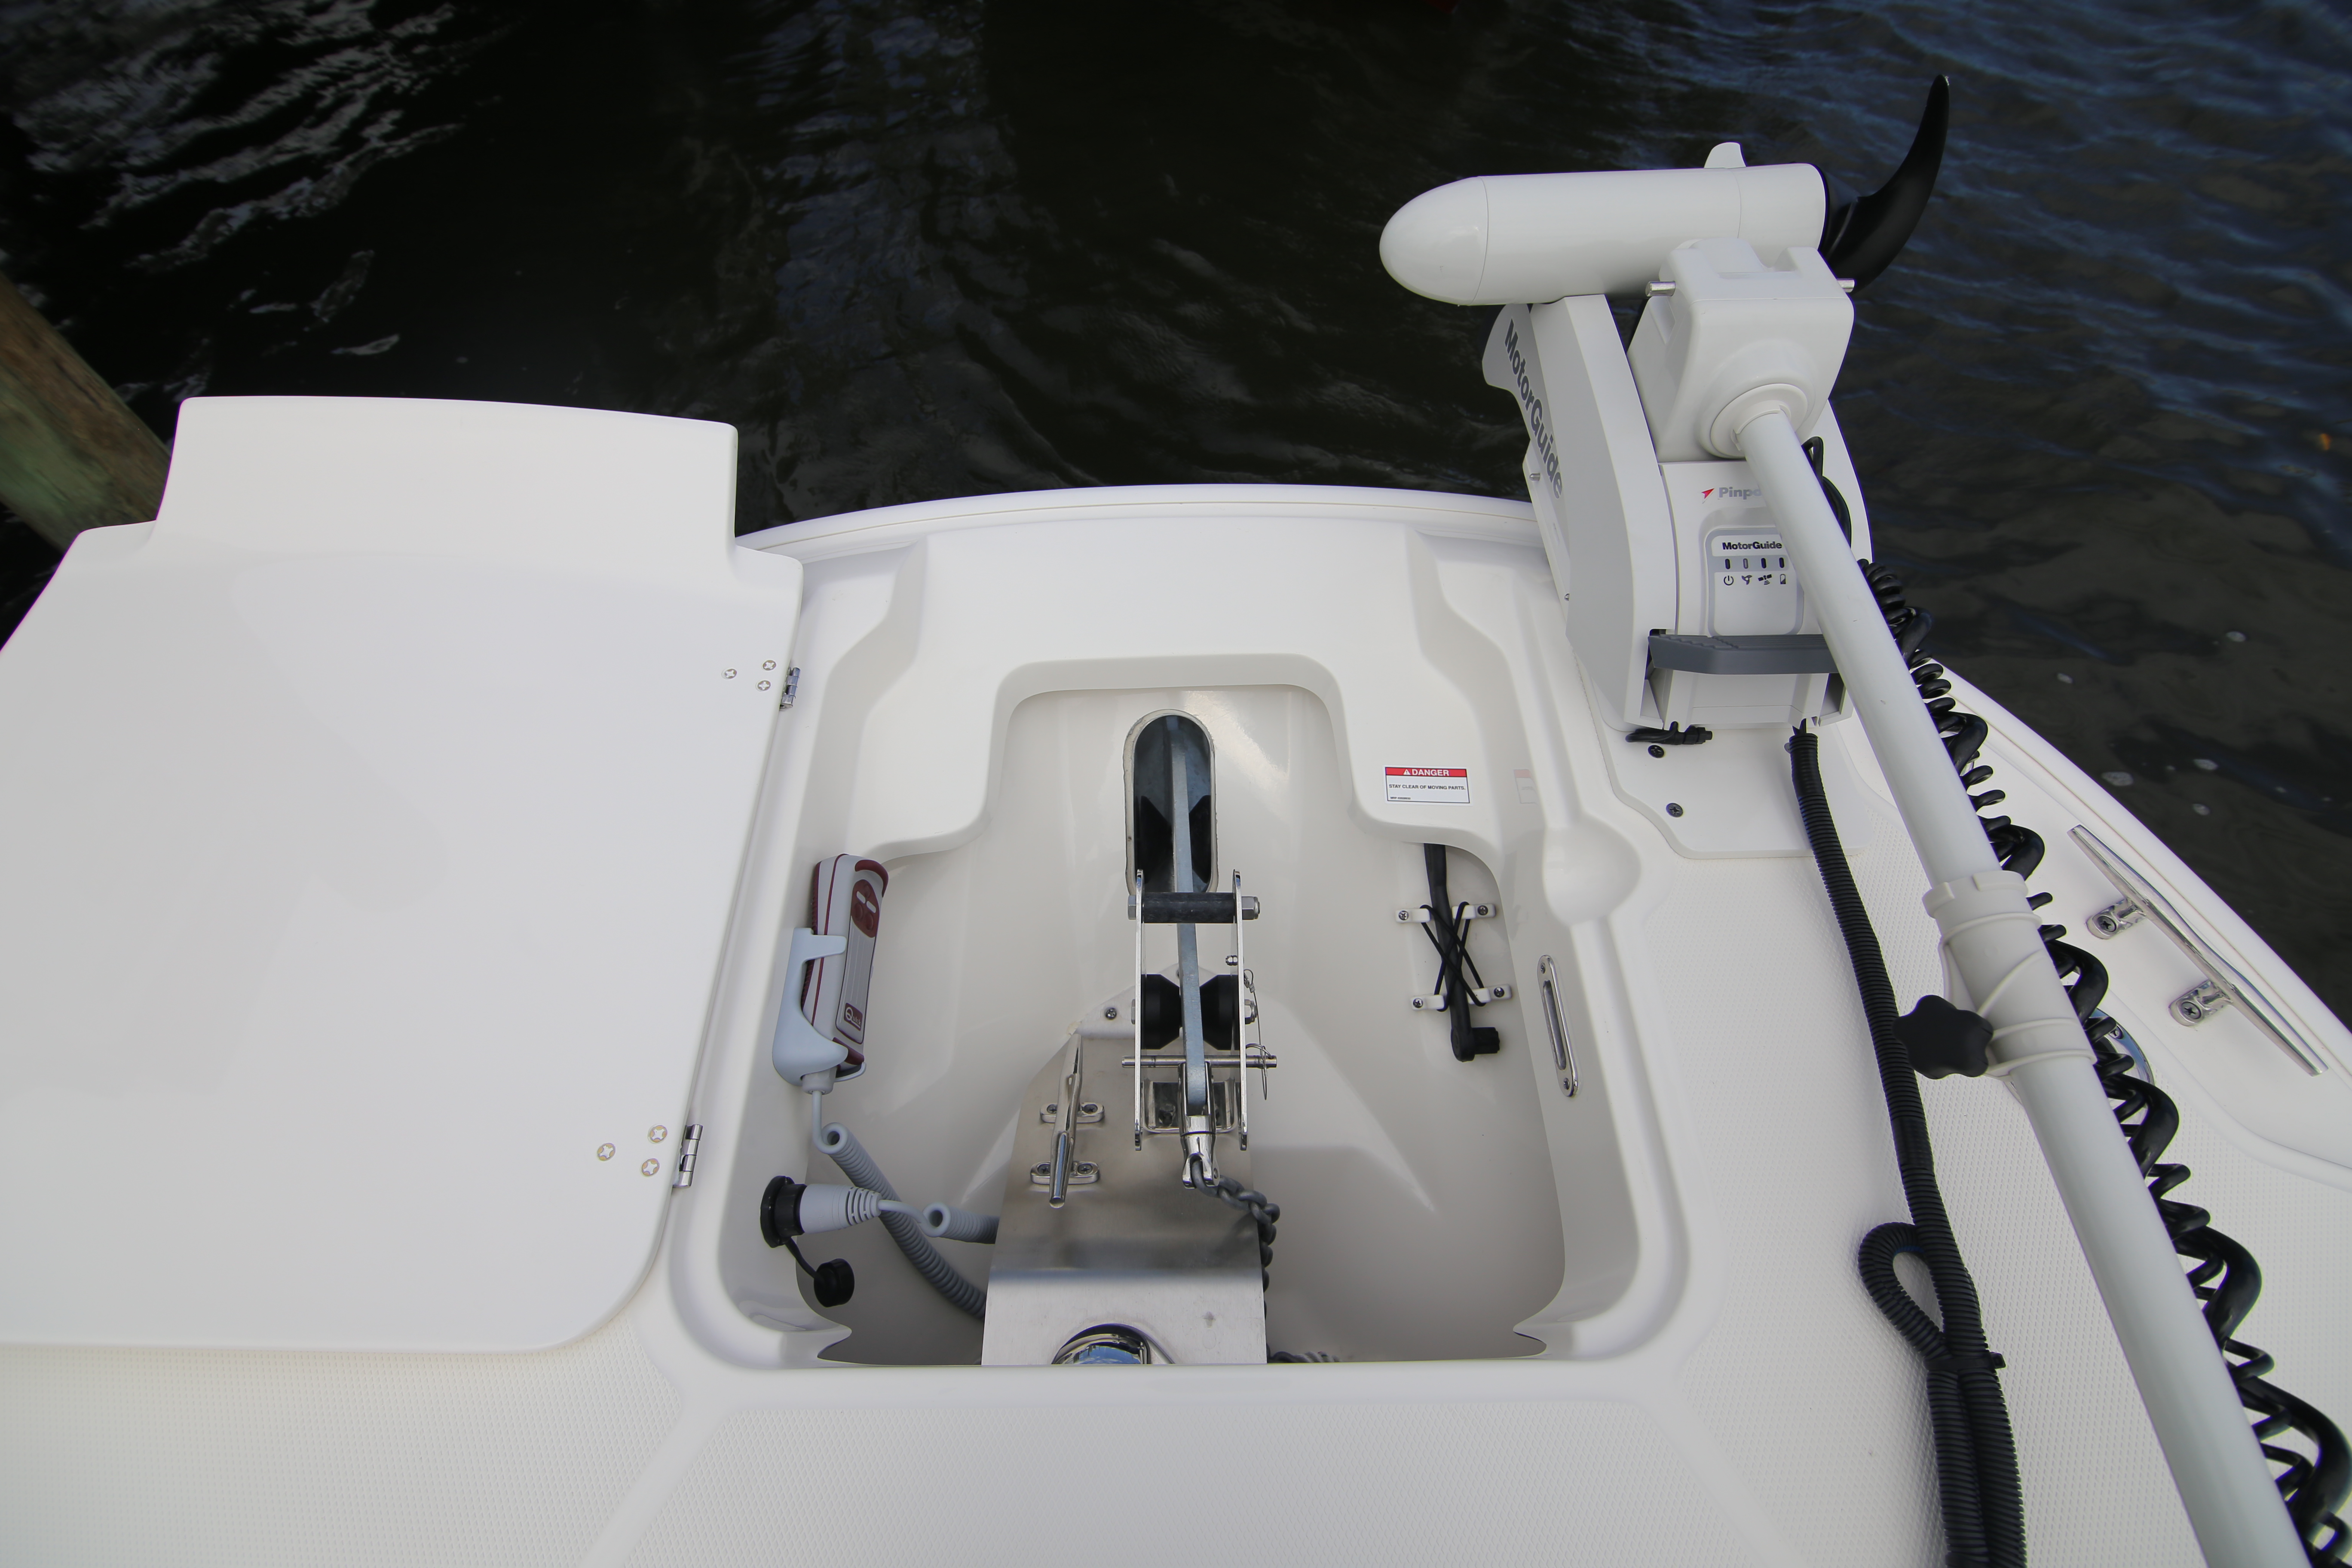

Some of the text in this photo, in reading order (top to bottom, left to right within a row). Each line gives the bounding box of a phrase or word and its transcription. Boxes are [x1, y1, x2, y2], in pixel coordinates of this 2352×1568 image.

[1504, 318, 1562, 499] MotorGuide
[1718, 487, 1762, 500] Pinpo
[1722, 541, 1782, 550] MotorGuide
